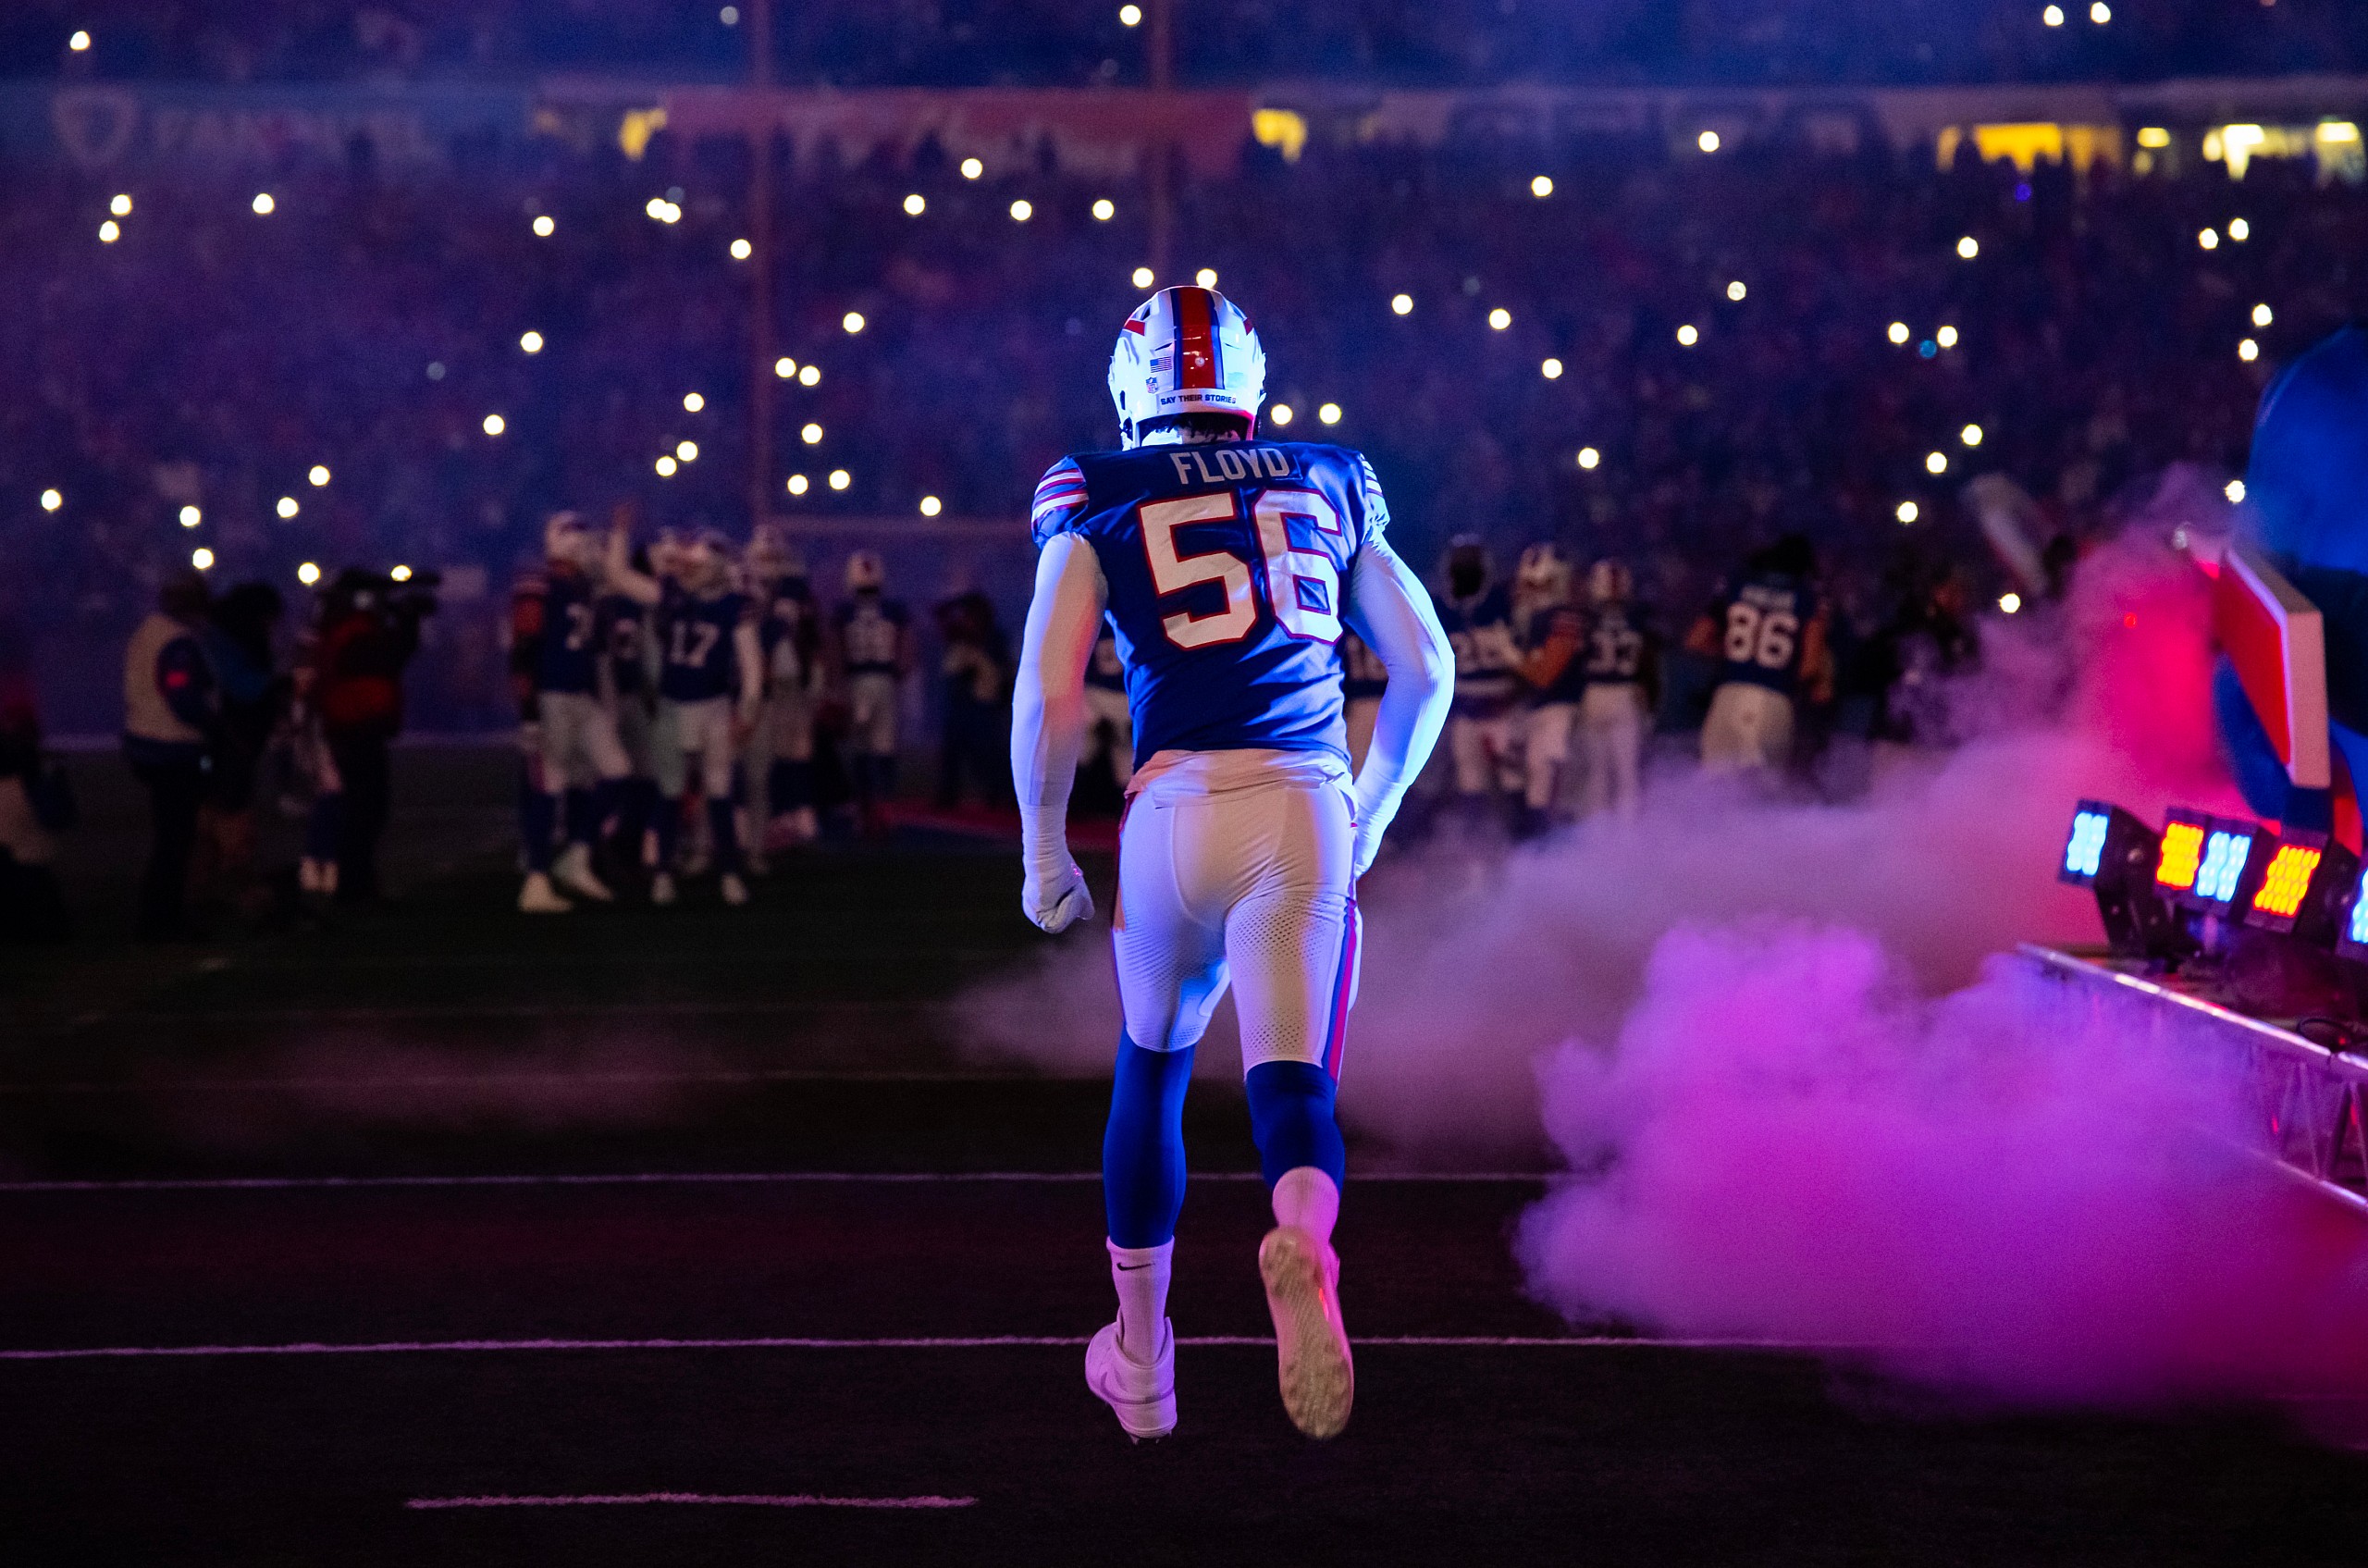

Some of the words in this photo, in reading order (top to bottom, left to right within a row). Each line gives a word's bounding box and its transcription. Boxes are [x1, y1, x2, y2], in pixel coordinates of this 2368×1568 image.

[1161, 395, 1176, 405] SAY
[1178, 394, 1202, 402] THEIR
[1204, 394, 1236, 404] STORIES
[1169, 447, 1290, 485] FLOYD
[1135, 485, 1345, 652] 56
[669, 619, 722, 669] 17
[1724, 600, 1800, 671] 86
